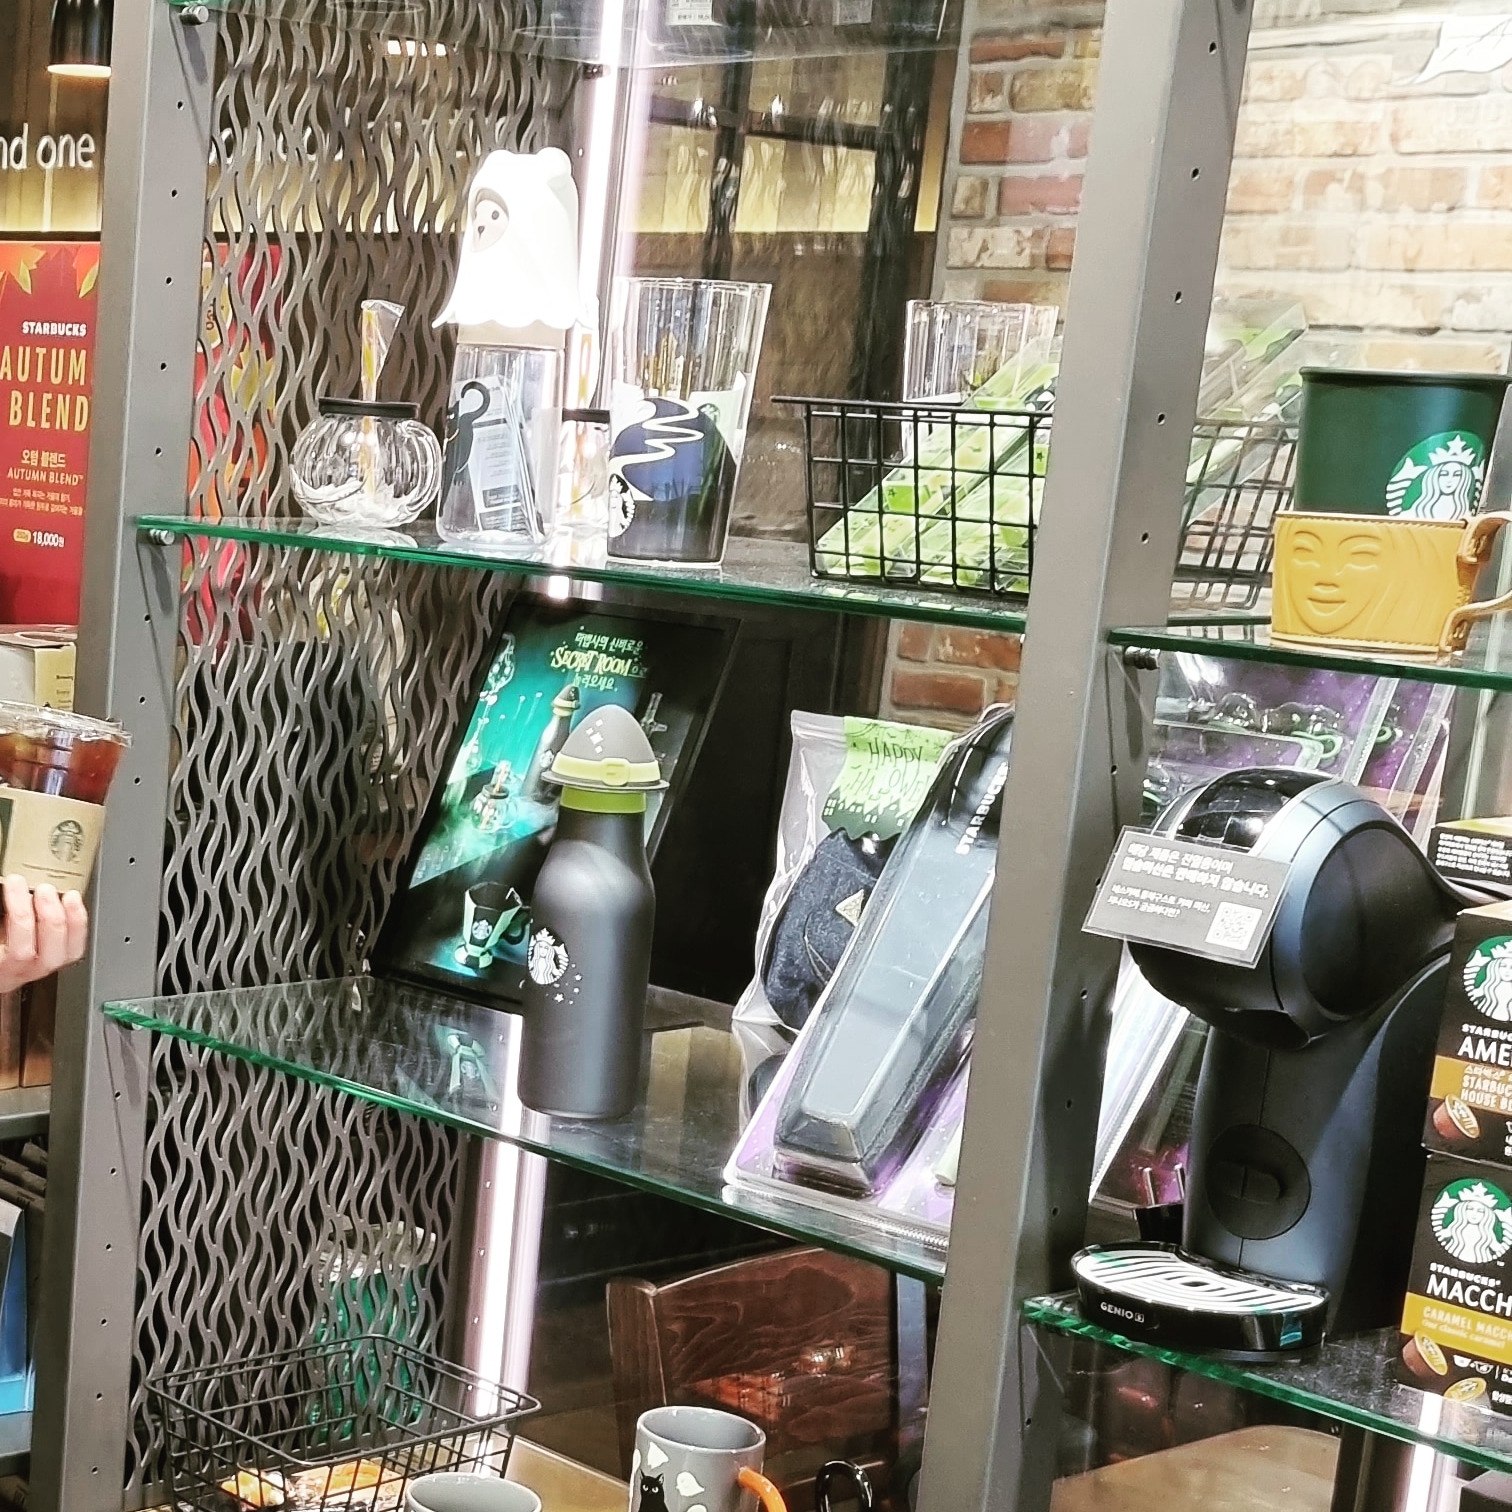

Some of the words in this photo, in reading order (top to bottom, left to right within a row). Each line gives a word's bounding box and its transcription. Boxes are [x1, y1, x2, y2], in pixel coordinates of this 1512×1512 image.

[36, 133, 96, 170] one
[22, 320, 87, 337] STARBUCKS
[9, 390, 89, 432] BLEND
[41, 450, 66, 468] 블렌드
[7, 467, 47, 483] AUTUMN
[609, 637, 644, 655] 신비로운
[550, 646, 599, 673] SECRET
[868, 737, 923, 770] HAPPY
[1221, 875, 1270, 899] 않습니다.
[1461, 1023, 1512, 1042] STARBUC
[1457, 1035, 1512, 1068] AME
[1462, 1074, 1512, 1098] STARBUC
[1460, 1088, 1497, 1109] HOUSE
[1426, 1273, 1512, 1318] MACCH
[1100, 1301, 1134, 1320] GENIO
[1422, 1305, 1473, 1330] CARAMEL
[1476, 1321, 1512, 1342] MACCH
